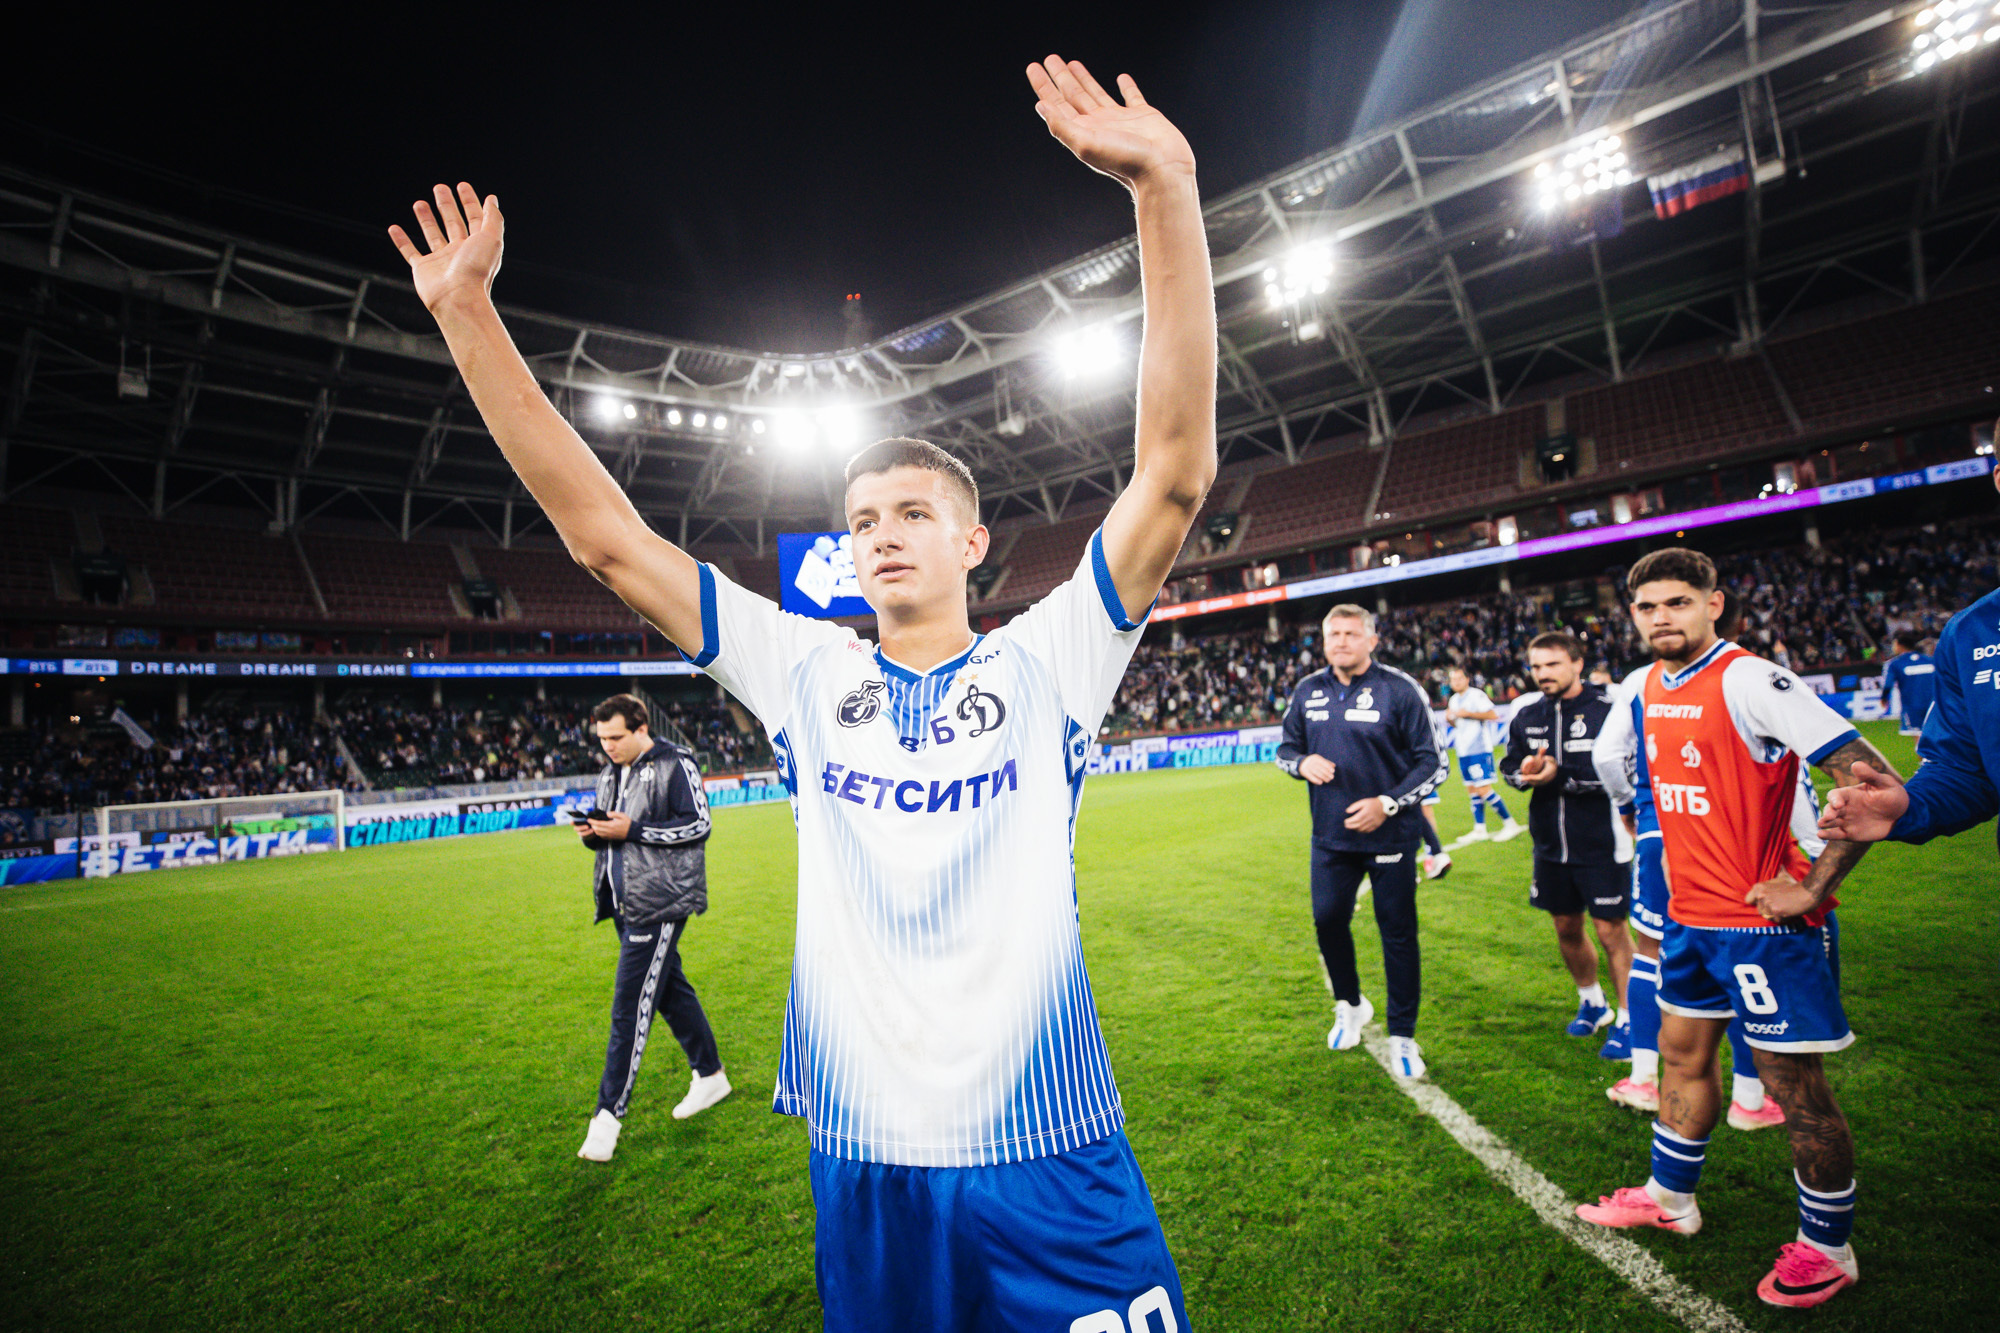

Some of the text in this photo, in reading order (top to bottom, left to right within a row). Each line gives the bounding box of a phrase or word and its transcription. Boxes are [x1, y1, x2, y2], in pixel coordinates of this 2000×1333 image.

[131, 661, 217, 675] DREAME
[240, 663, 317, 676] DREAME
[337, 664, 406, 676] DREAME
[1646, 703, 1703, 719] БЕТСИТИ
[821, 758, 1018, 813] БЕТСИТИ
[1660, 782, 1711, 816] ВТБ
[350, 817, 432, 848] СТАВКИ
[434, 815, 460, 838] НА
[464, 808, 522, 835] СПОРТ
[81, 829, 308, 879] БЕТСИТИ
[1732, 963, 1779, 1015] 8
[1744, 1021, 1785, 1036] BOSCO
